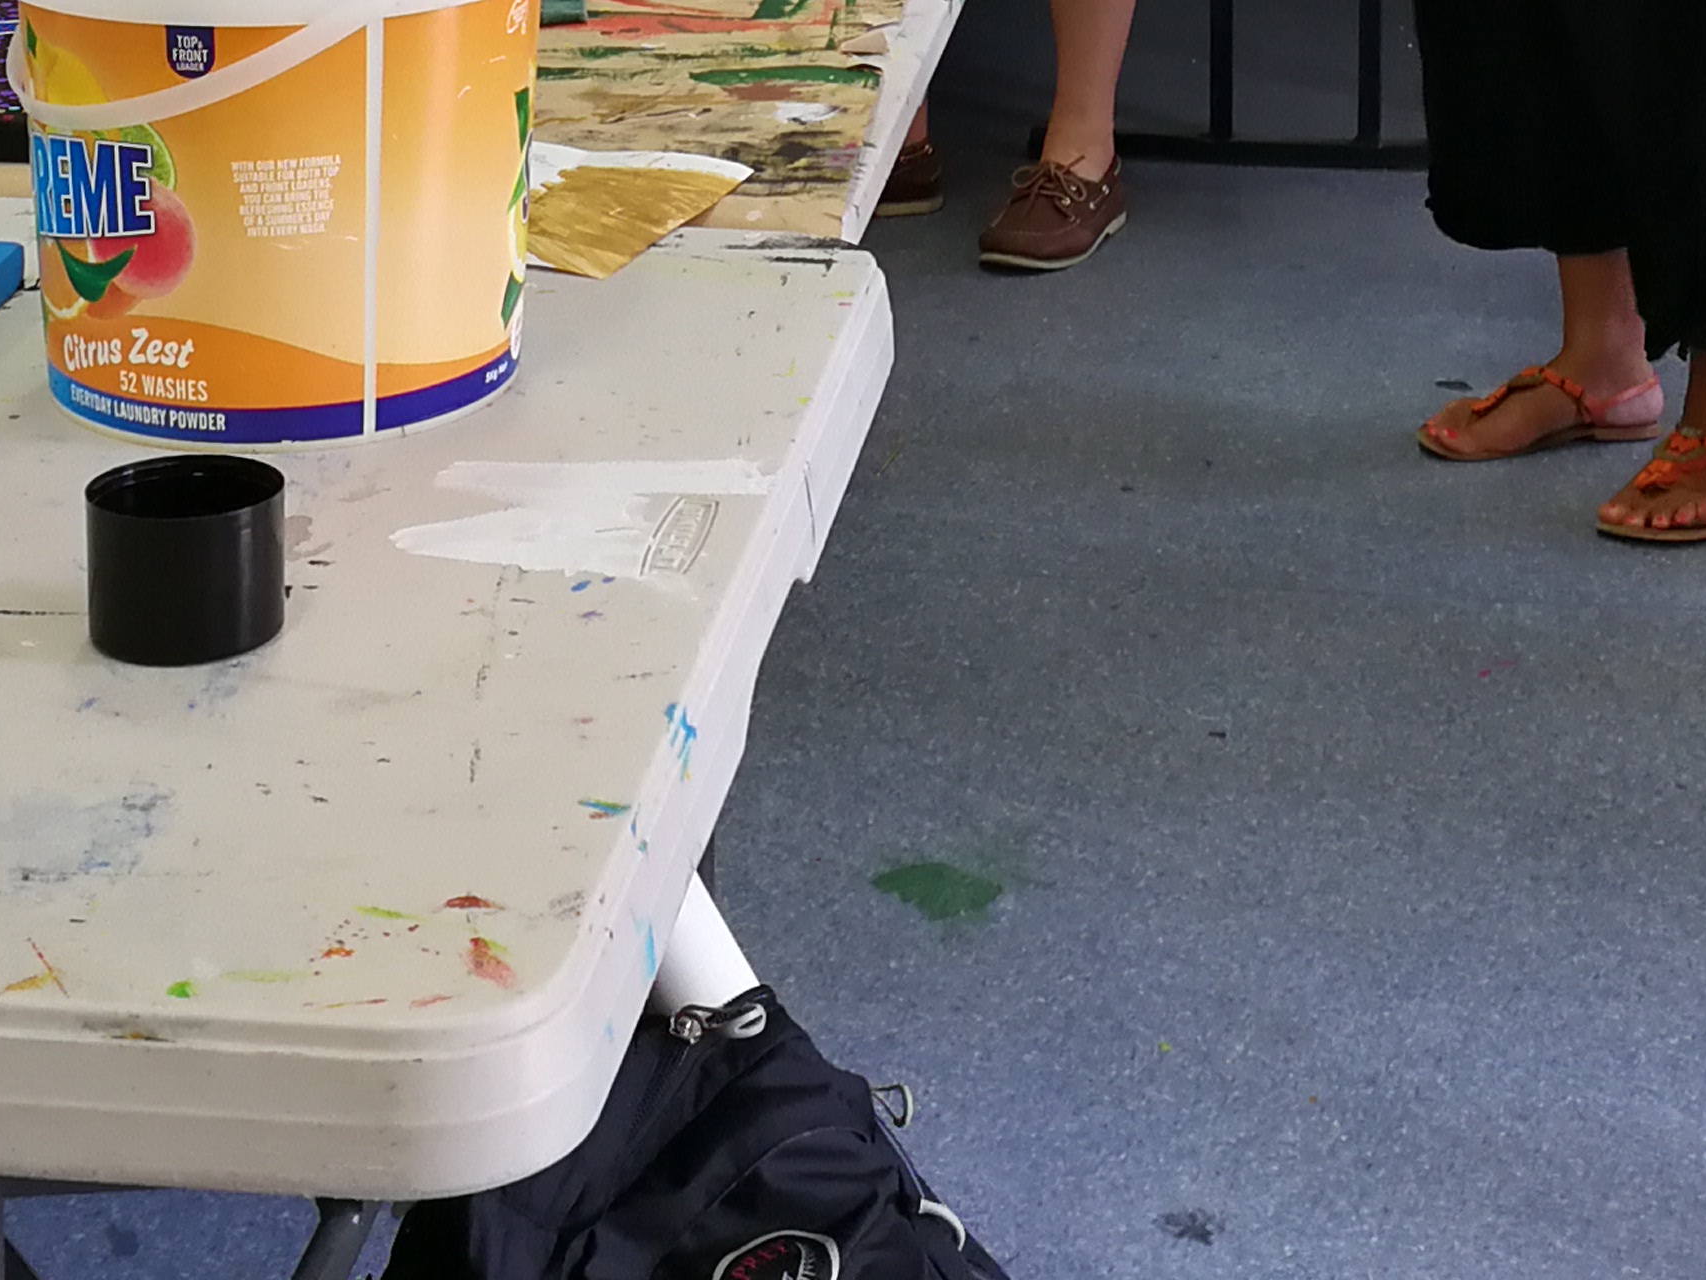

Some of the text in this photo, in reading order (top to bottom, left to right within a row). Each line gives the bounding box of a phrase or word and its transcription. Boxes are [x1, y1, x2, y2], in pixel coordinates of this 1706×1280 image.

[172, 48, 209, 63] FRONT
[277, 159, 297, 170] NEW
[299, 154, 342, 168] FORMULA
[233, 166, 340, 183] SUITABLE FOR BOTH TOP
[31, 131, 156, 238] REME
[239, 182, 258, 193] AND
[261, 181, 289, 192] FRONT
[263, 193, 282, 204] CAN
[239, 199, 334, 215] REFRESHING ESSENCE
[243, 216, 254, 227] OF
[257, 216, 263, 226] A
[314, 210, 332, 222] DAY
[247, 227, 268, 237] INTO
[270, 225, 298, 237] EVERY
[63, 327, 195, 372] Citrus Zest
[119, 370, 209, 402] 52 WASHES
[70, 384, 226, 431] EVERYDAY LAUNDRY POWDER
